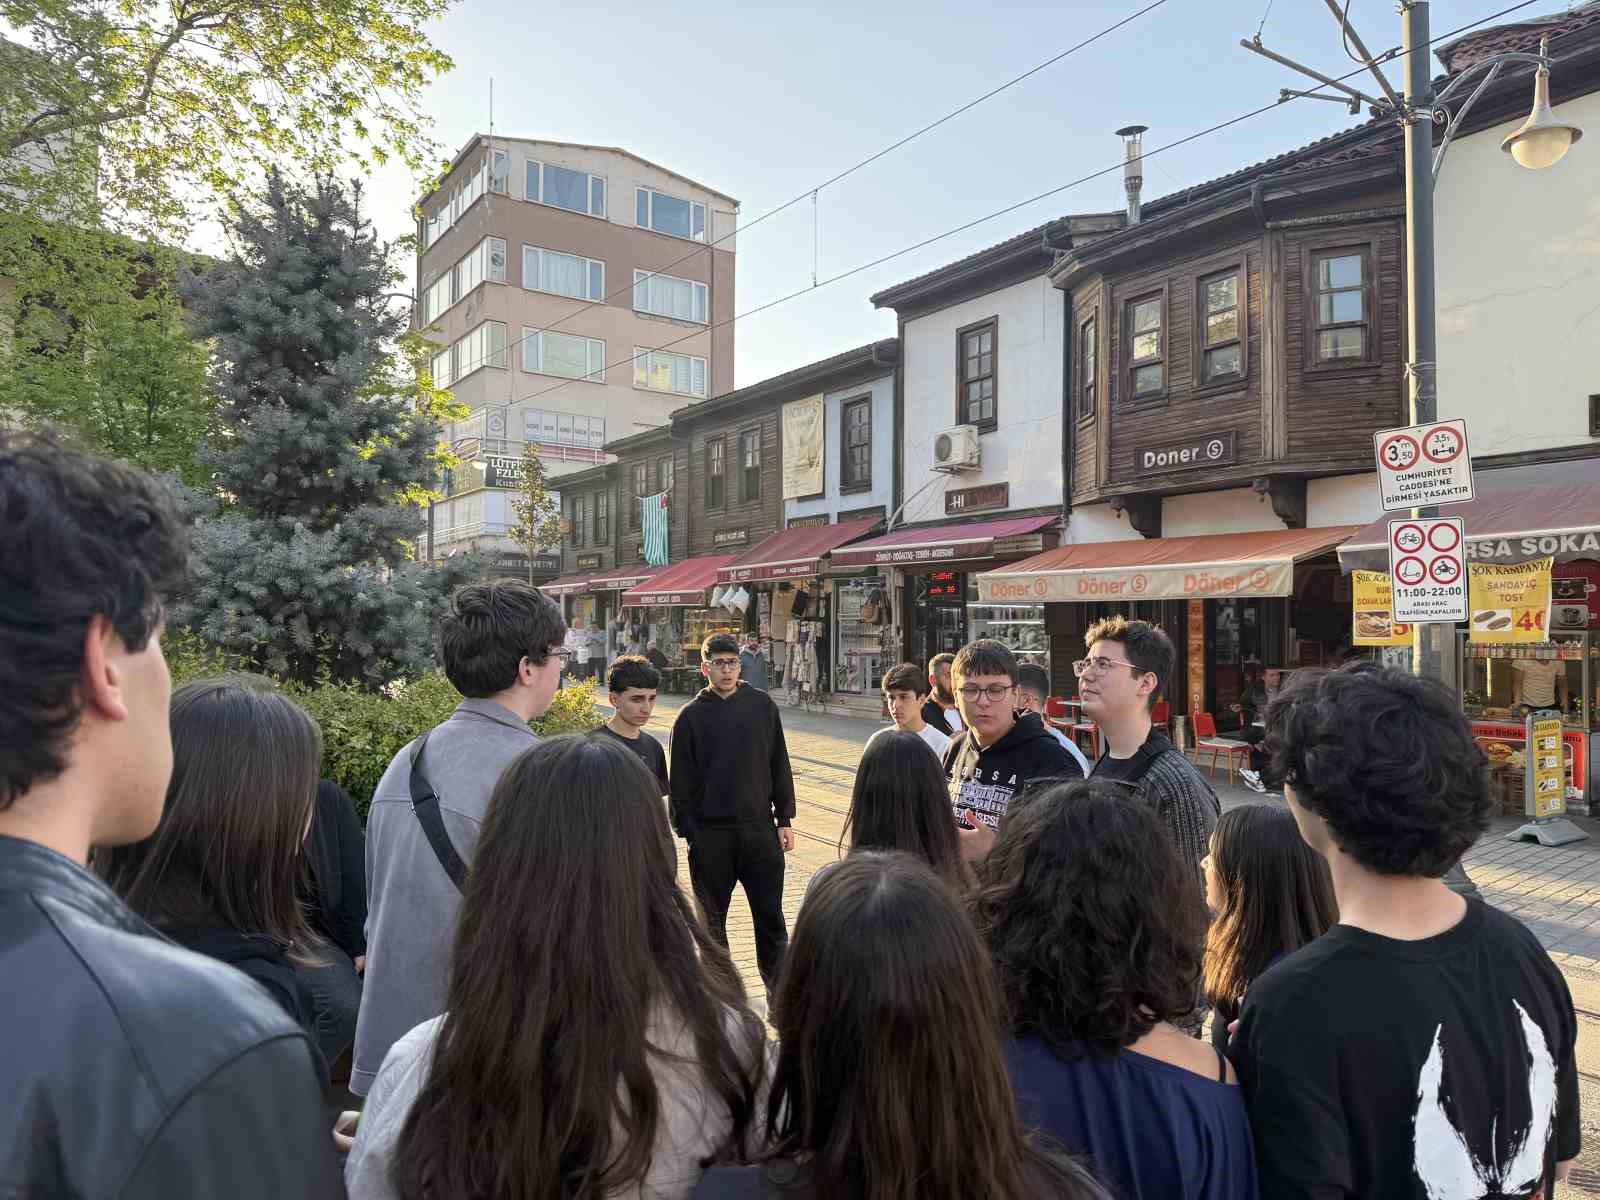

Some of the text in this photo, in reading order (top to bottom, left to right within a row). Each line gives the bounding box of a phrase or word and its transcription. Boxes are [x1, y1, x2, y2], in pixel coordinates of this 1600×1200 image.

[1144, 447, 1199, 468] Doner
[1396, 467, 1453, 482] CUMHURİYET
[1400, 478, 1453, 492] CADDESİ'NE
[1386, 486, 1469, 504] GİRMESİ YASAKTIR
[1465, 533, 1600, 558] RSA SOKA
[990, 579, 1030, 597] Döner
[1078, 573, 1127, 595] Döner
[1183, 570, 1243, 592] Döner
[1398, 586, 1462, 598] 11:00-22:00
